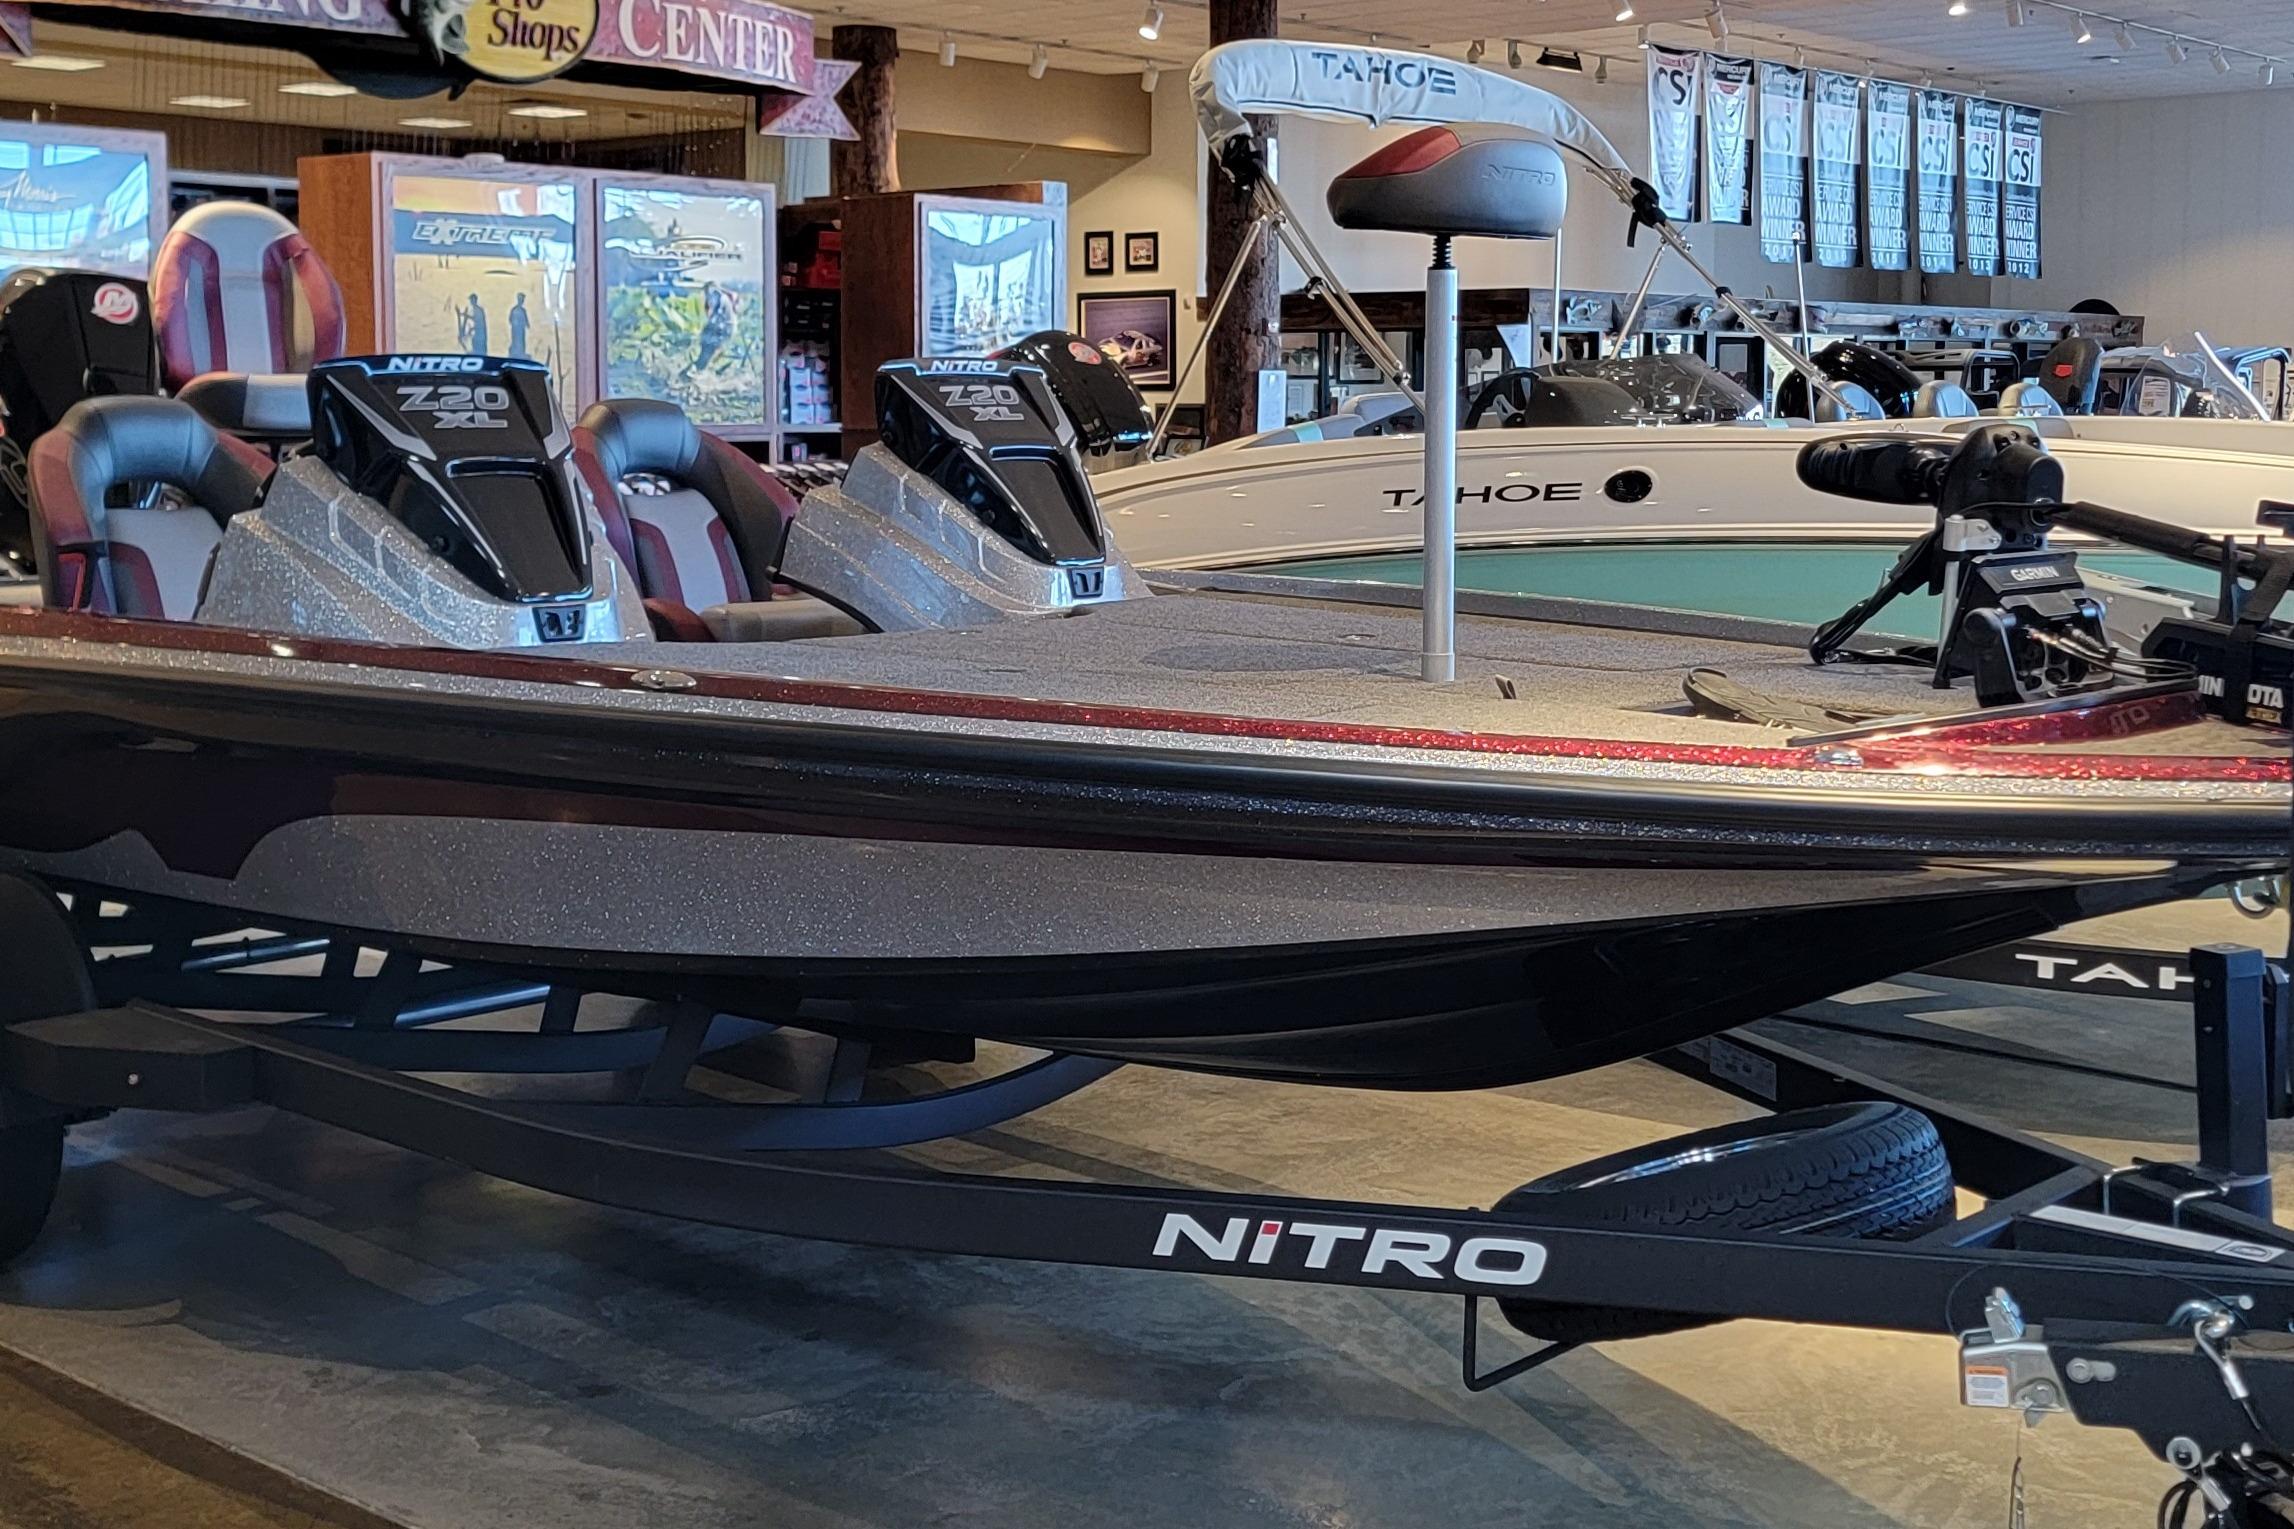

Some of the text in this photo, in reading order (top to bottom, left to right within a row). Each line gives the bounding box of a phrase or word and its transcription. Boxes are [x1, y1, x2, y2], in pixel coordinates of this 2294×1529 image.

[487, 8, 580, 61] Shops
[619, 0, 797, 83] CENTER
[1311, 52, 1457, 95] TAHOE
[1482, 164, 1557, 186] NITRO
[1761, 195, 1800, 219] AWARD
[1814, 200, 1853, 224] AWARD
[2006, 204, 2025, 220] ERVICE
[1814, 222, 1857, 246] WINNER
[386, 356, 485, 372] NITRO
[930, 360, 999, 372] NITRO
[396, 385, 510, 412] Z20
[938, 384, 1020, 407] Z20
[431, 410, 509, 429] XL
[967, 406, 1025, 422] XL
[1382, 482, 1583, 506] THOE
[2010, 566, 2060, 581] GARMIN
[2246, 683, 2285, 709] OTA
[2015, 953, 2195, 991] TAH
[1152, 1212, 1548, 1286] NITRO
